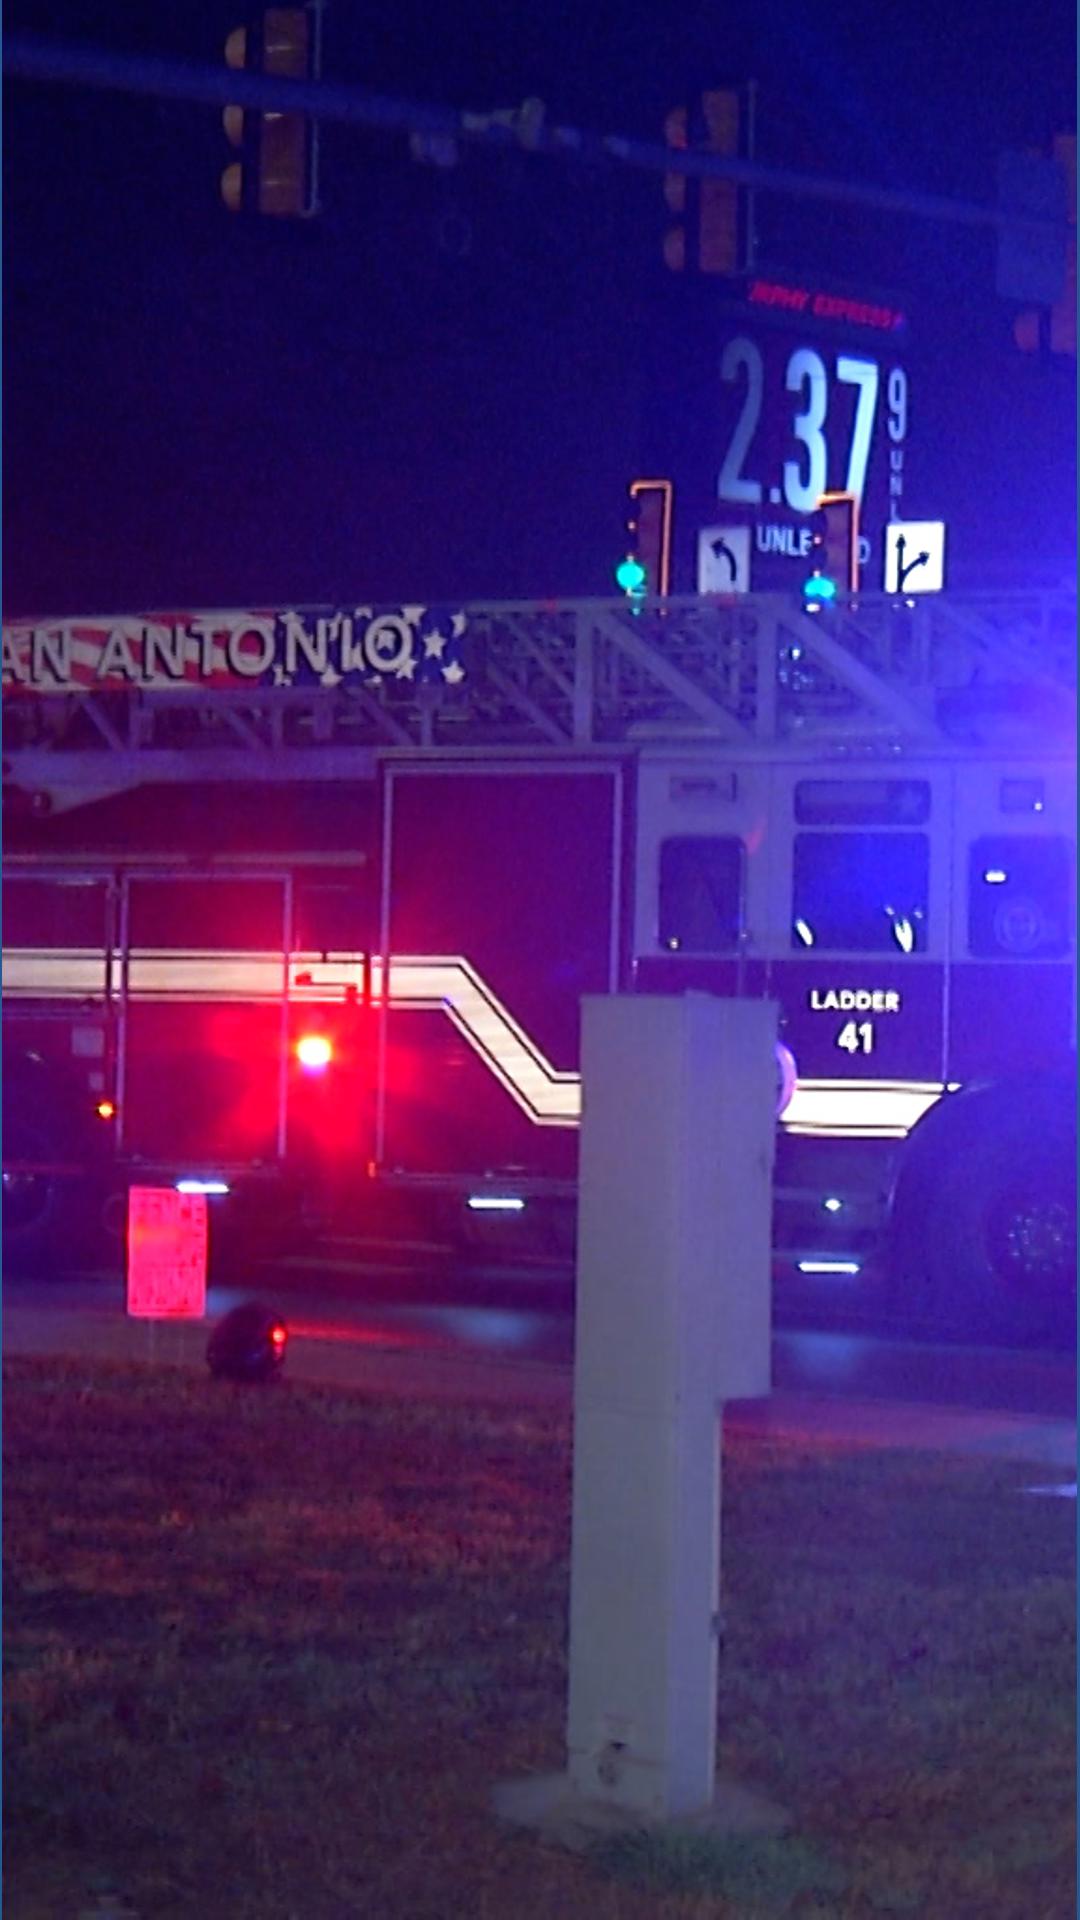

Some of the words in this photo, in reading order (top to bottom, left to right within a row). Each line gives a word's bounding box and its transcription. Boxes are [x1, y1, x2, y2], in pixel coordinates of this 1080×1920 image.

[97, 613, 413, 682] ANTONIO
[810, 989, 900, 1013] LADDER
[838, 1020, 873, 1054] 41
